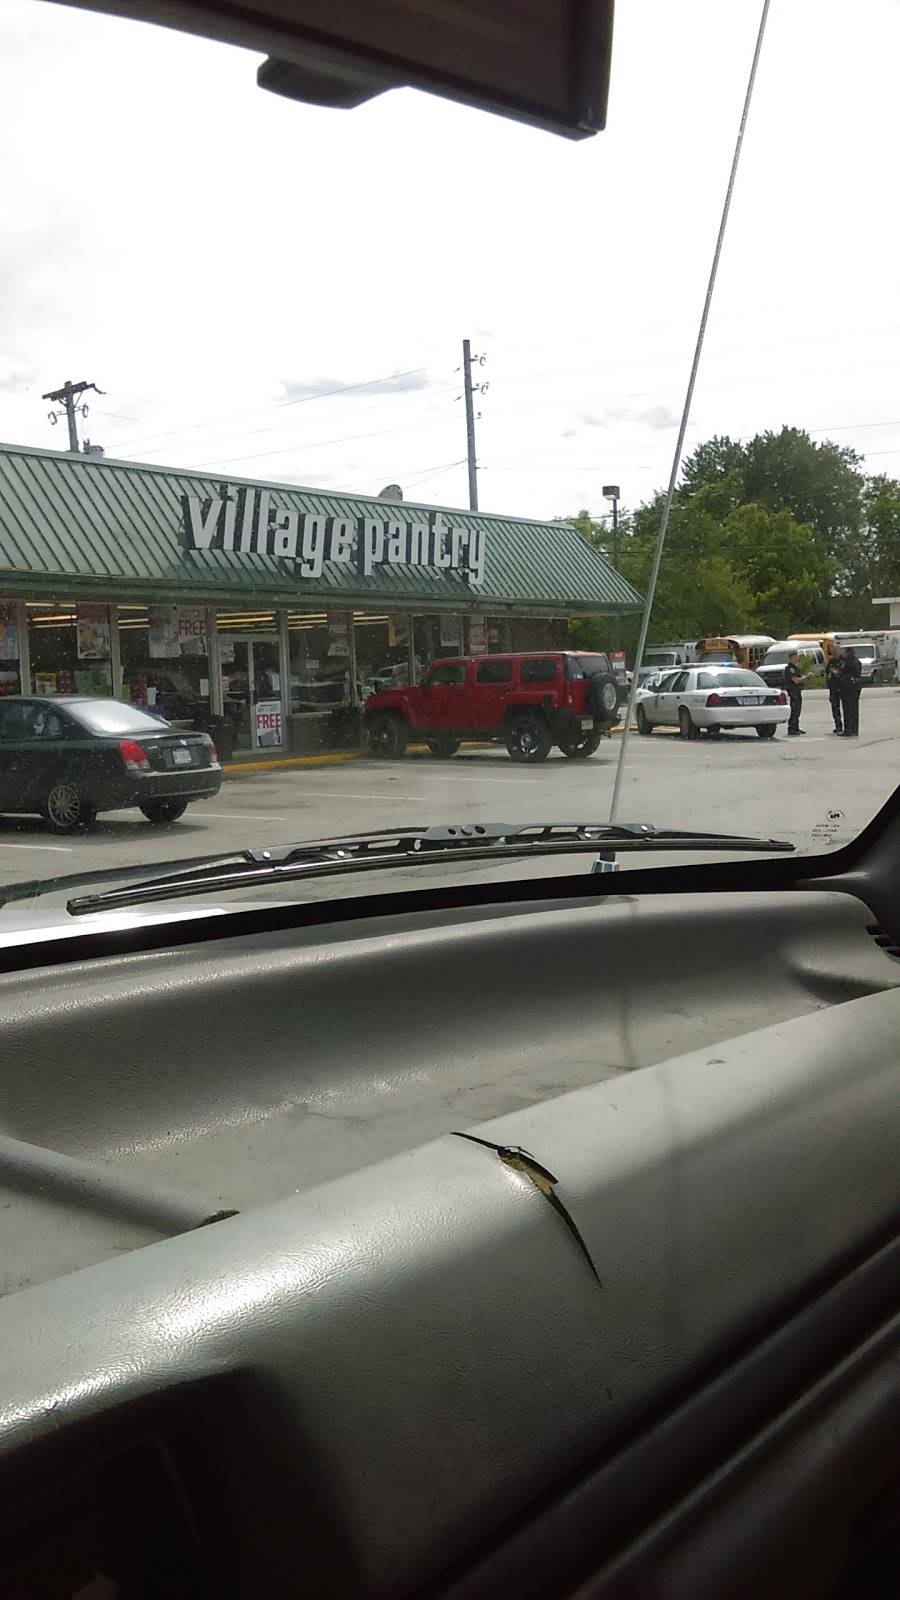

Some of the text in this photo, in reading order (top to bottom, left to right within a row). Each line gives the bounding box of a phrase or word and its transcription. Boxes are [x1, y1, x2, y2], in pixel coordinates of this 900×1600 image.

[187, 485, 486, 585] village pantry
[177, 619, 207, 636] FREE
[256, 713, 281, 729] FREE
